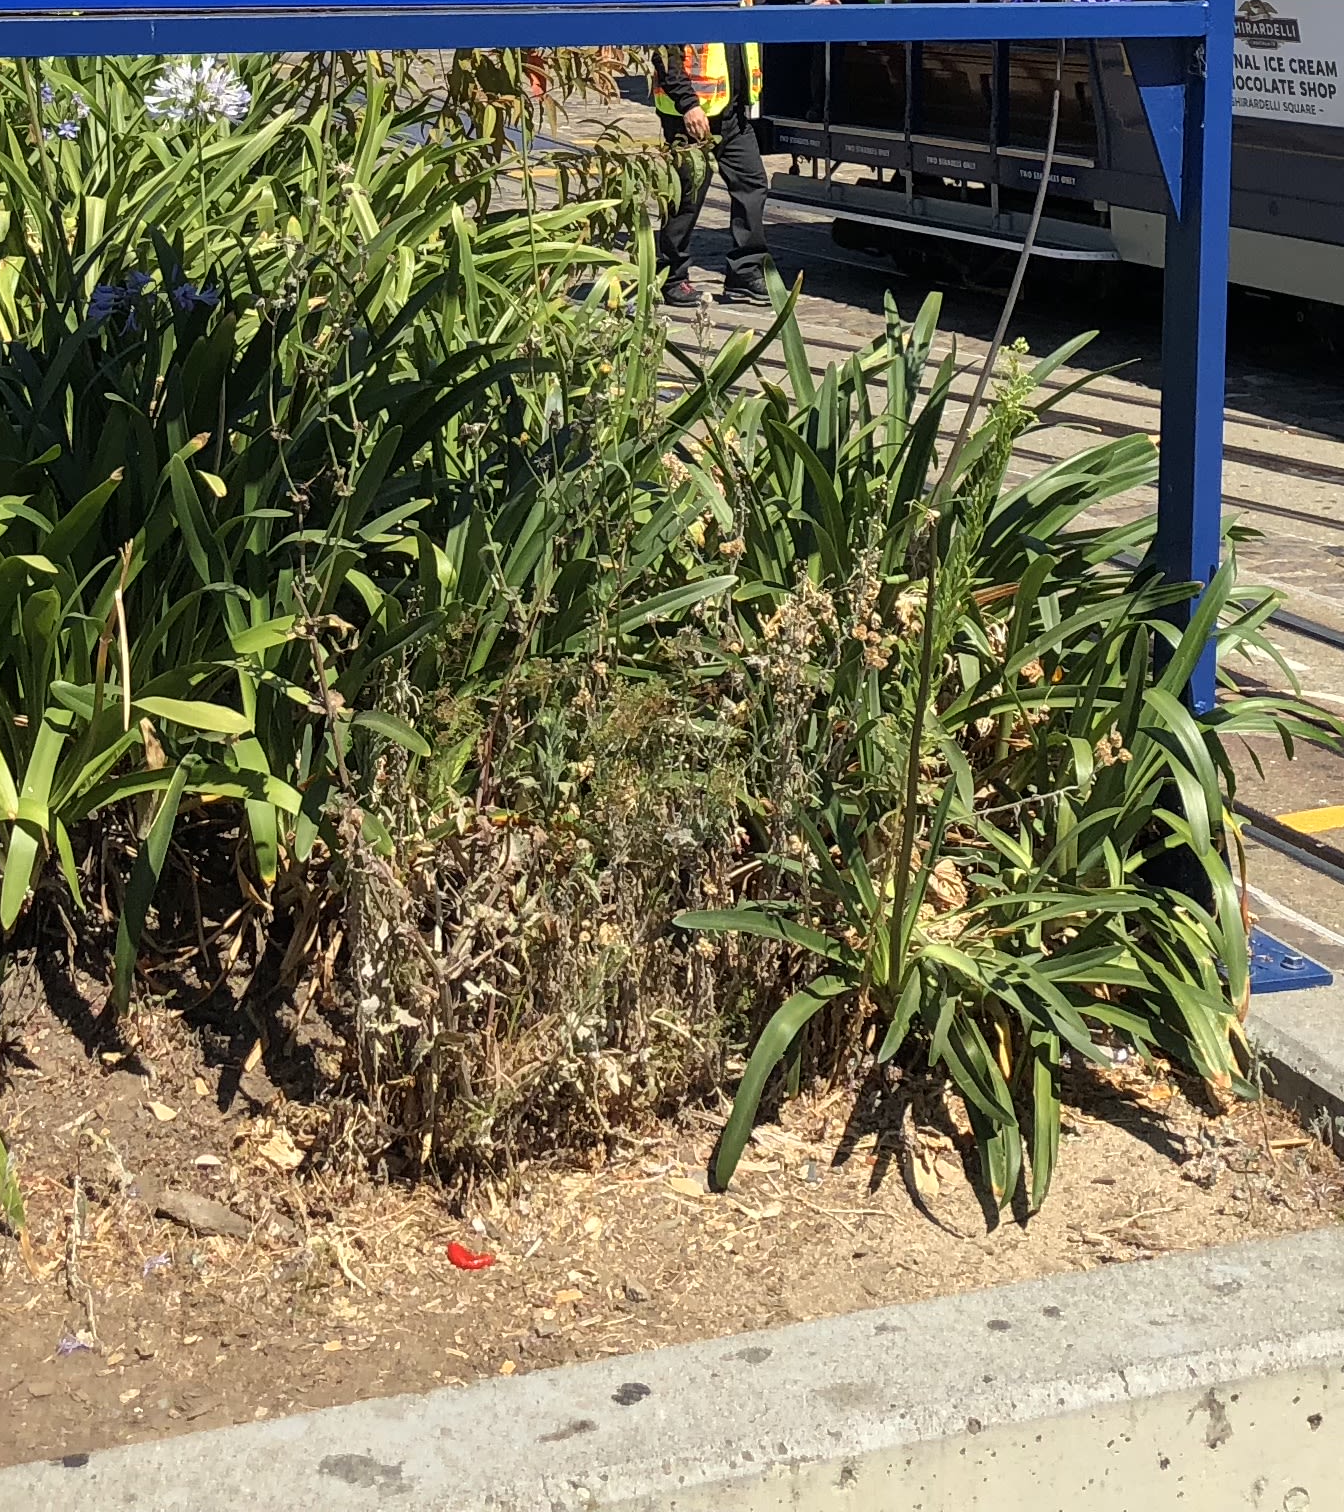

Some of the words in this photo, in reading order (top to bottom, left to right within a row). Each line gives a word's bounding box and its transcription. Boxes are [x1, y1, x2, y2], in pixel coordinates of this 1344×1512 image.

[1234, 21, 1297, 38] HIRARDELLI
[1233, 53, 1261, 71] NAL
[1263, 55, 1286, 73] ICE
[1289, 57, 1338, 78] CREAM
[1232, 75, 1296, 96] OCOLATE
[1299, 80, 1337, 100] SHOP
[1282, 101, 1317, 115] SQUARE
